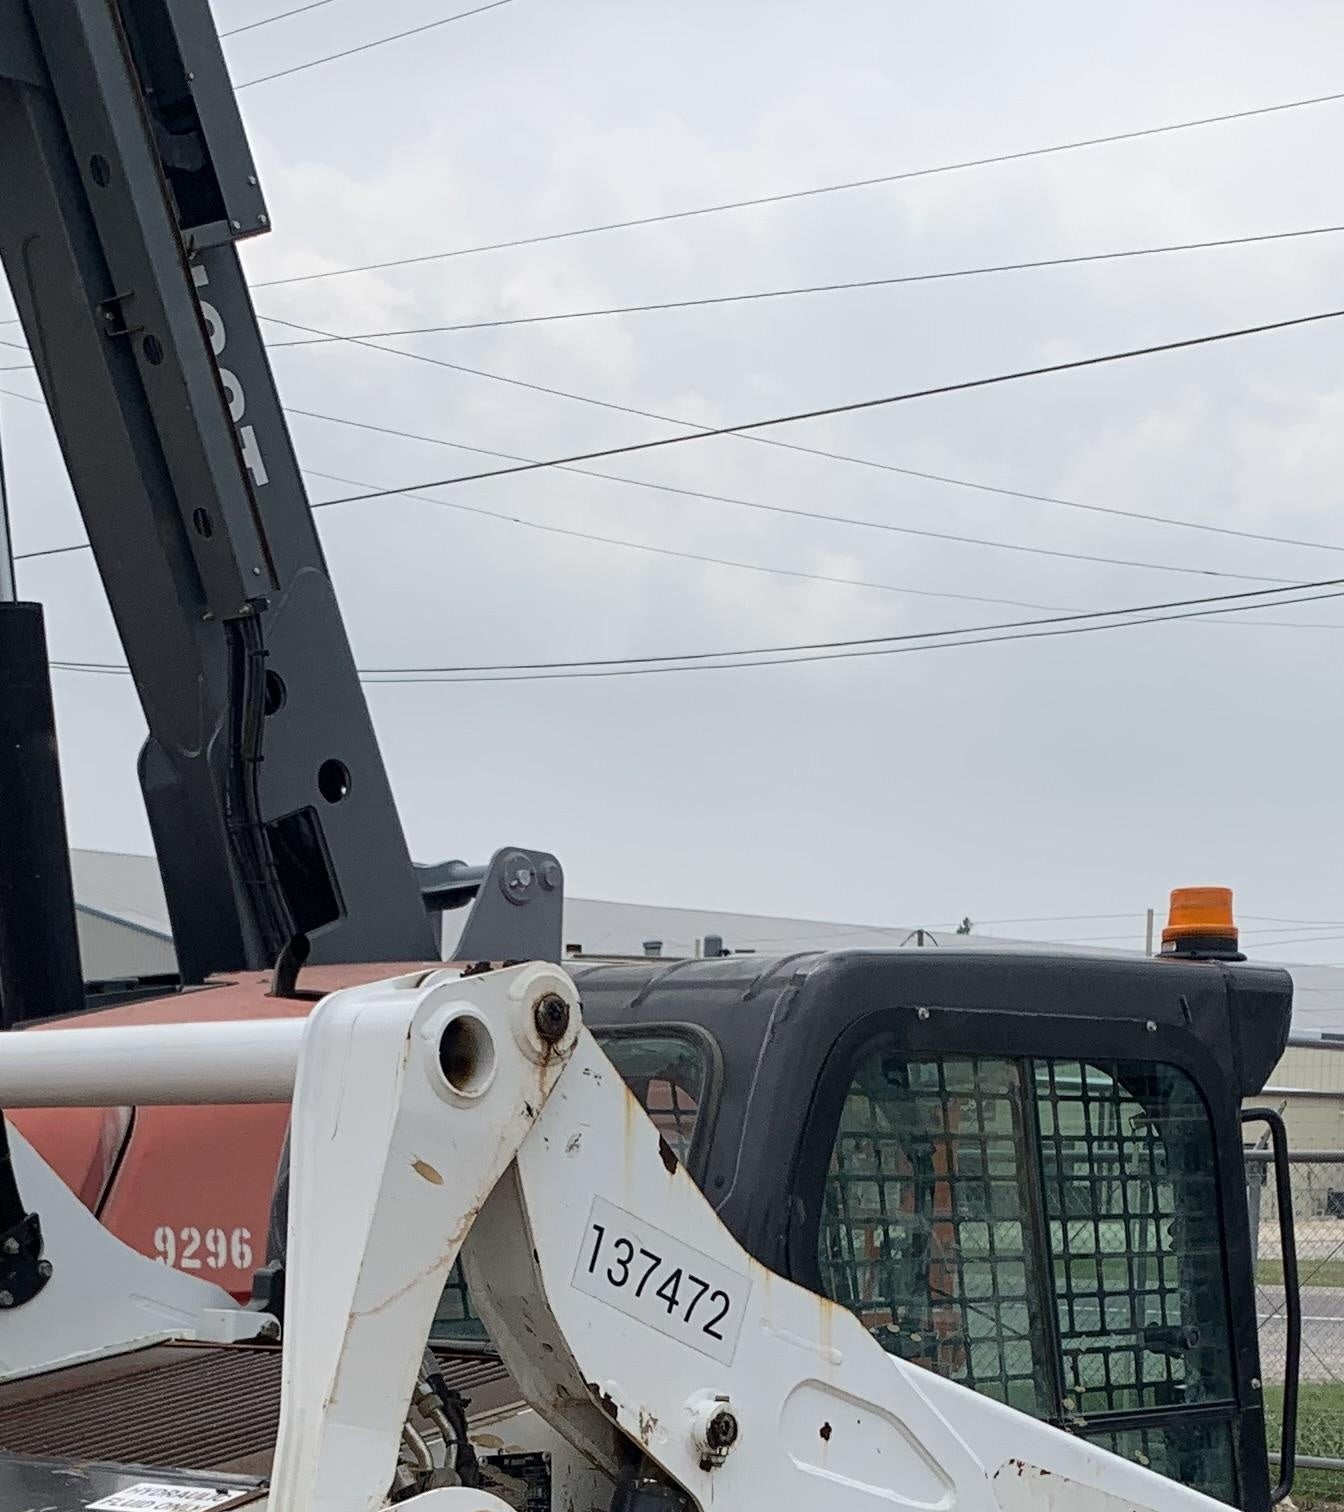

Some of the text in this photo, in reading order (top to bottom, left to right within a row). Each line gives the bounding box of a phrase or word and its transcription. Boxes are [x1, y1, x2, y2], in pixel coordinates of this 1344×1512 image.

[154, 1226, 253, 1269] 9296
[588, 1223, 730, 1341] 137472
[100, 1497, 155, 1508] FLUID
